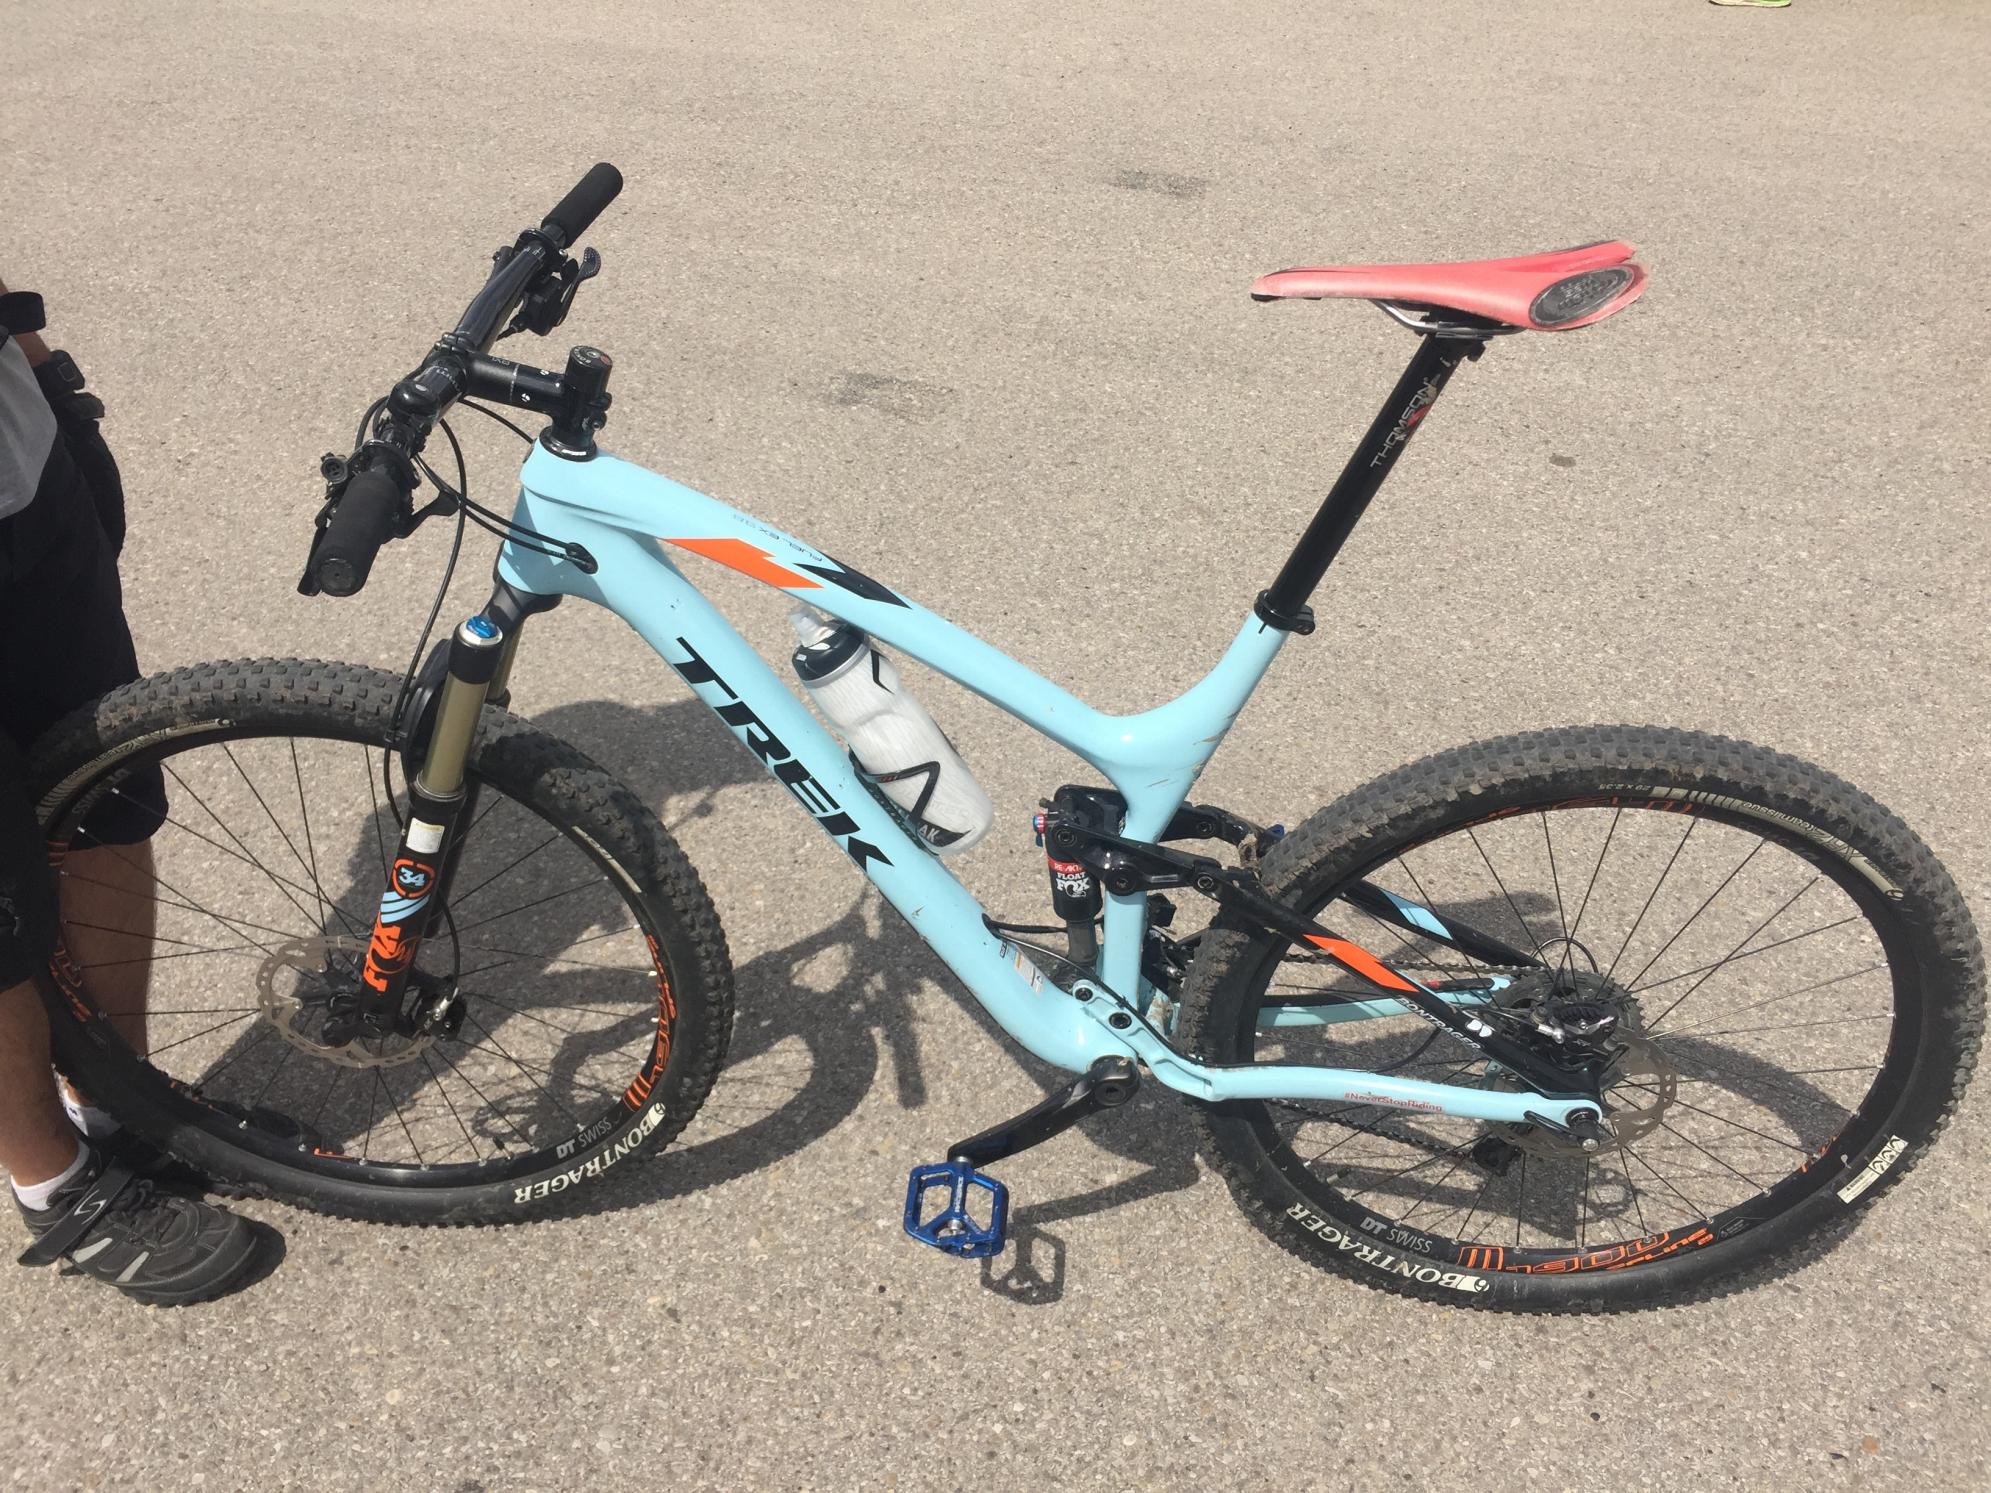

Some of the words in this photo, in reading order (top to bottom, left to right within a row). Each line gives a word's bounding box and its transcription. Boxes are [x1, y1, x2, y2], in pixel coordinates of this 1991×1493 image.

[673, 636, 895, 873] TREK
[398, 866, 426, 887] 34
[1055, 877, 1091, 896] FOX
[1056, 871, 1087, 881] FLOAT
[1397, 996, 1482, 1050] BONTRAGER
[1343, 1092, 1443, 1113] #NeverStopRiding
[513, 1106, 662, 1205] BONTRAGER
[555, 1138, 577, 1159] DT
[577, 1116, 613, 1149] SWISS
[1286, 1202, 1483, 1293] BONTRAGER
[1359, 1216, 1388, 1236] DT
[1386, 1228, 1434, 1254] SWISS
